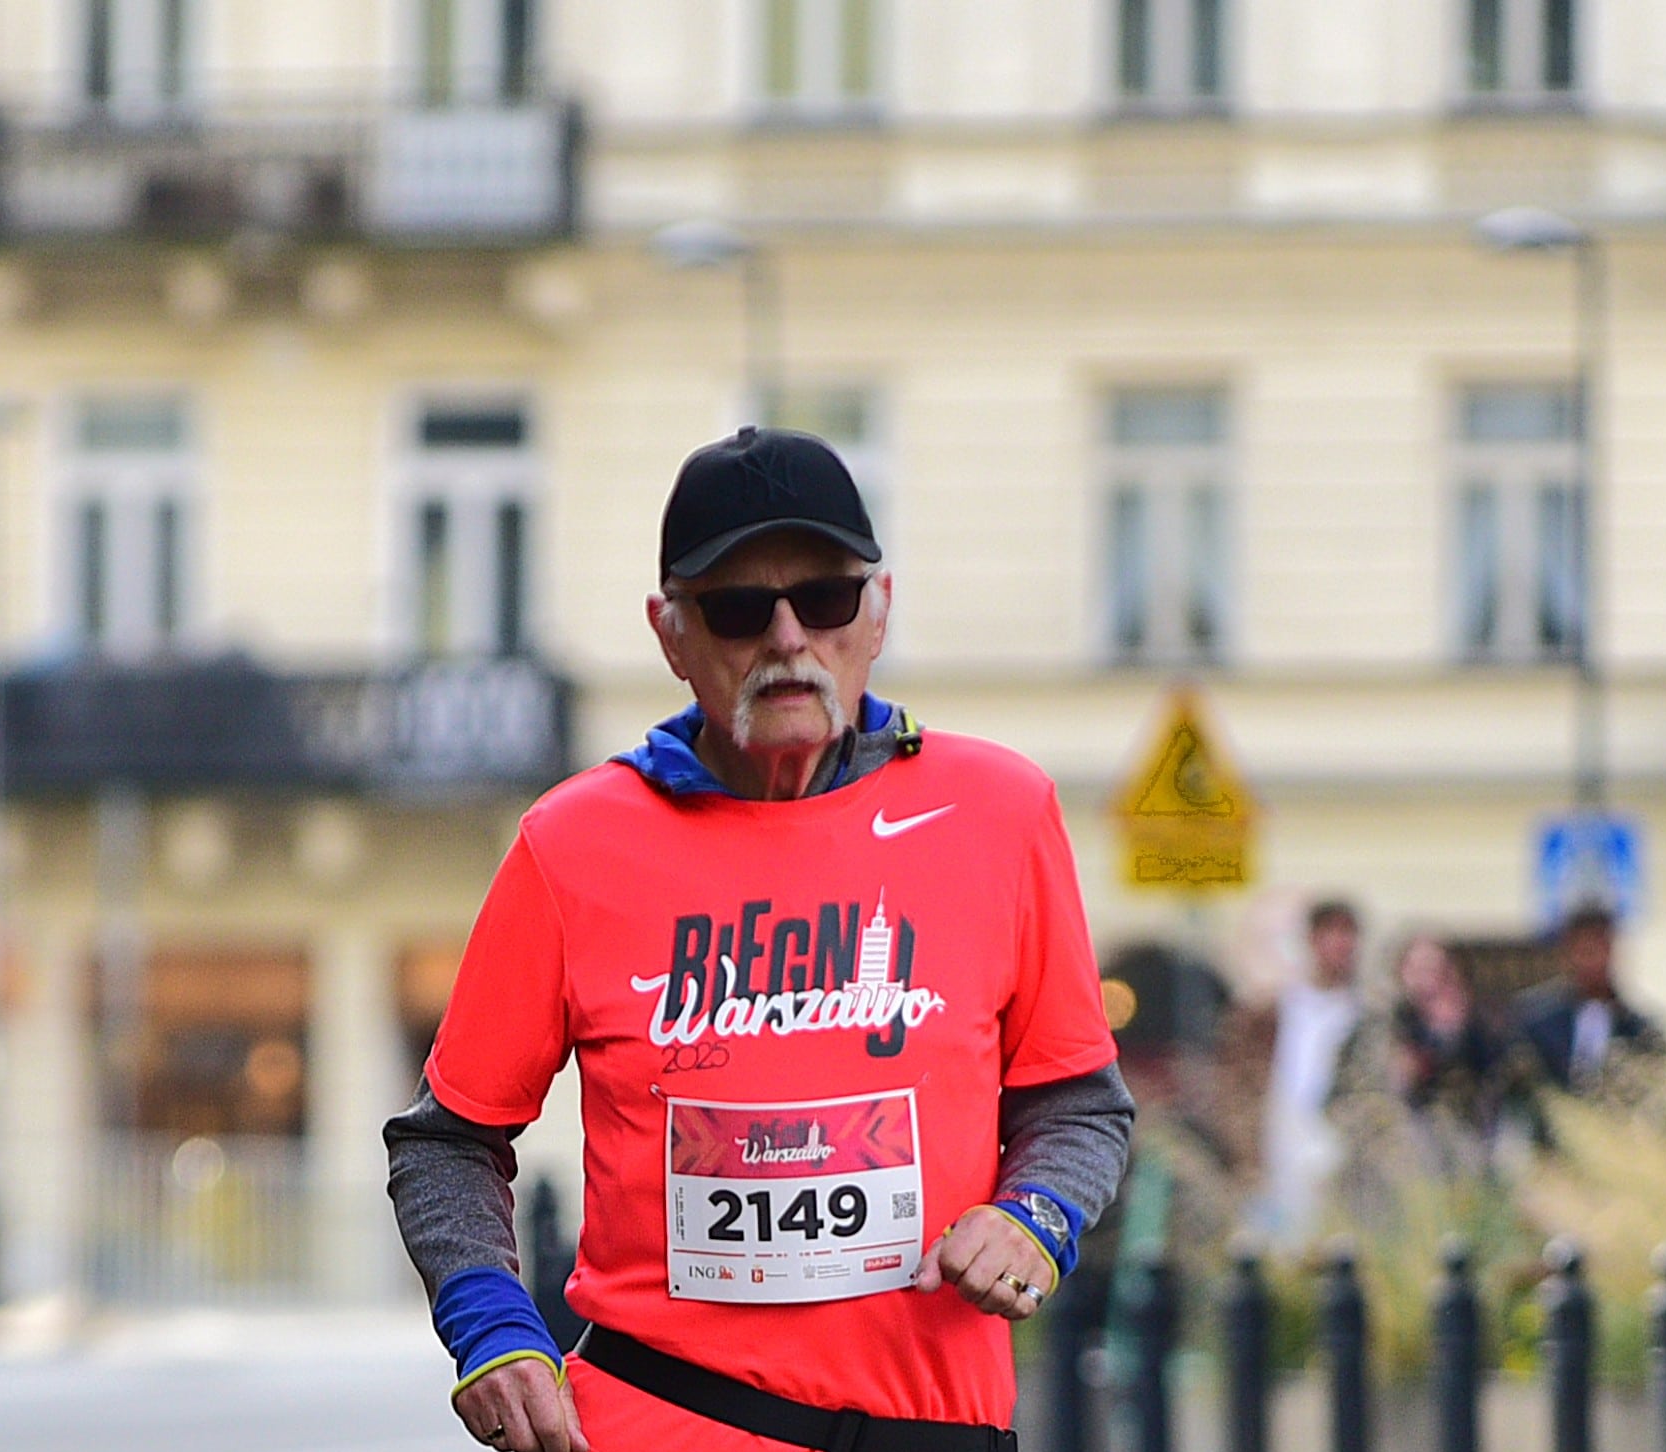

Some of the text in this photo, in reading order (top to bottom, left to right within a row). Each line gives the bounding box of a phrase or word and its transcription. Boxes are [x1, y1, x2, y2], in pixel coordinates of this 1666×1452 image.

[630, 953, 946, 1046] Warszawo
[660, 1041, 730, 1074] 2025
[735, 1134, 837, 1165] Warszawo
[708, 1184, 868, 1242] 2149
[689, 1265, 716, 1279] ING
